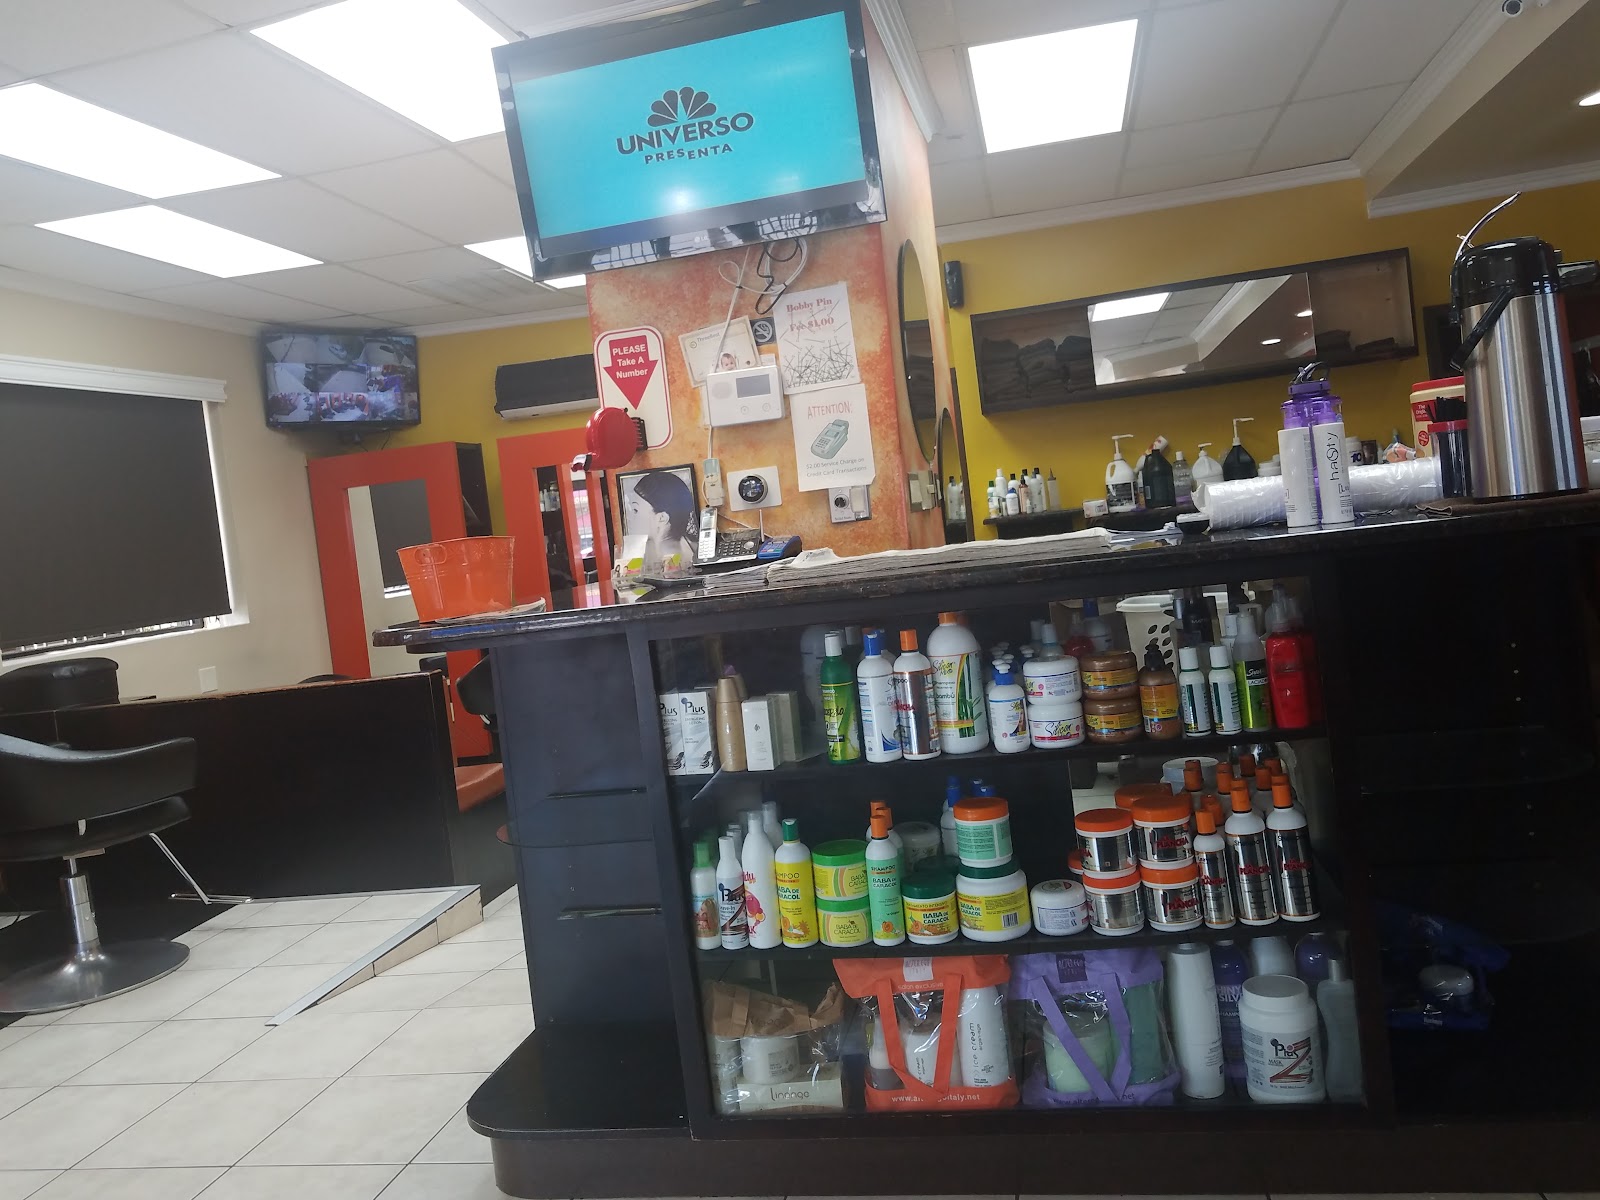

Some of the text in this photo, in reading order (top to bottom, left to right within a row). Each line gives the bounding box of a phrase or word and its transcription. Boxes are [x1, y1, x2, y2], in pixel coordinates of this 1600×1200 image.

[616, 112, 754, 155] UNIVERSO
[645, 143, 733, 165] PRESENTA
[786, 298, 832, 313] Bobby Pin
[807, 317, 835, 328] $1.00
[612, 344, 647, 356] PLEASE
[617, 356, 645, 367] Take A
[616, 369, 649, 379] Number
[685, 701, 706, 715] Plus
[923, 911, 943, 919] BABA
[923, 916, 950, 925] CARACOL
